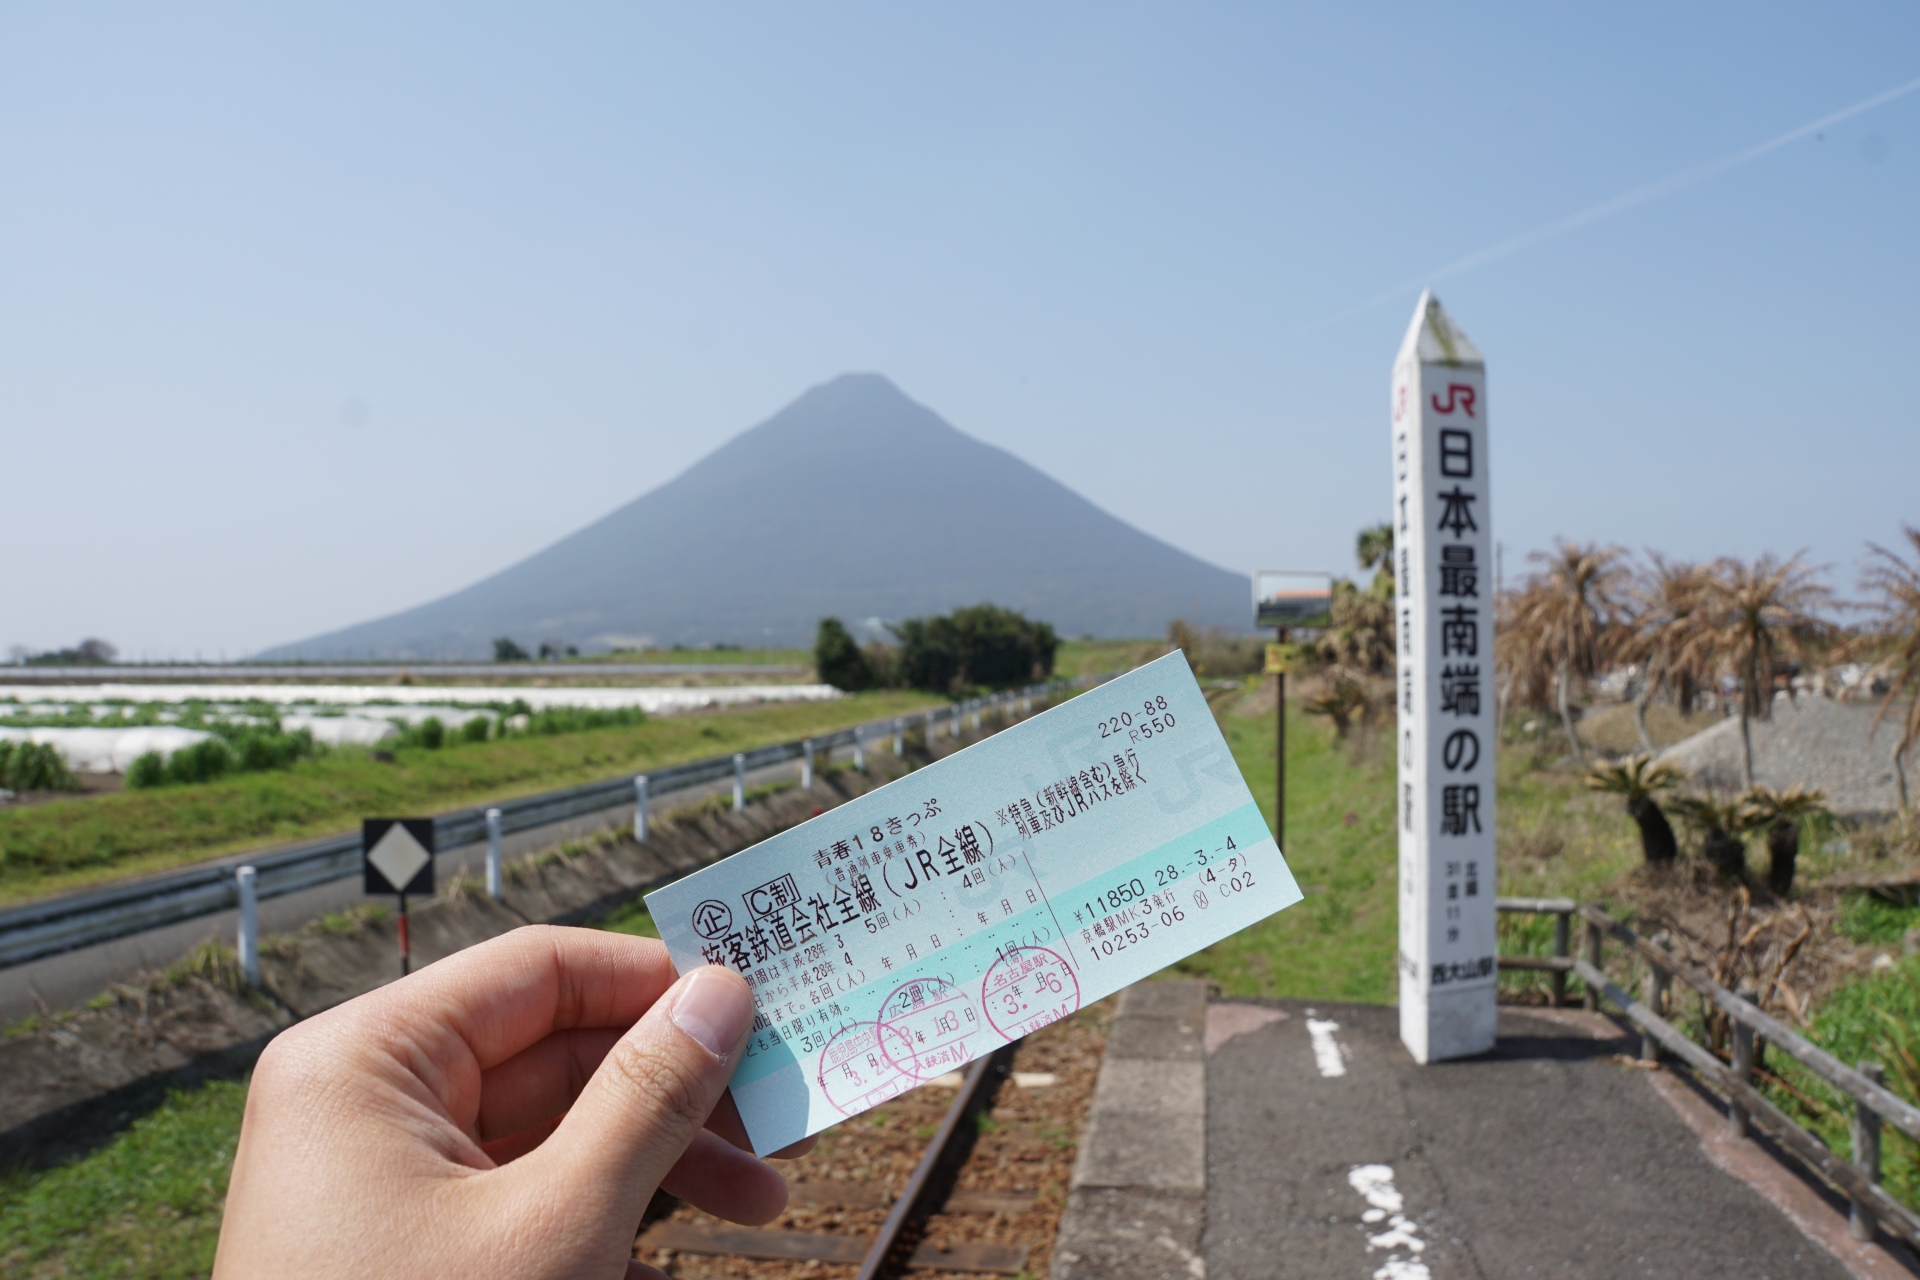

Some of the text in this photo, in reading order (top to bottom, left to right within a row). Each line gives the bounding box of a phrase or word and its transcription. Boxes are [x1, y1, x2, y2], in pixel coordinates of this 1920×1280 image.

[1431, 383, 1477, 418] JR
[1438, 427, 1482, 836] 日本最南端の駅
[1097, 694, 1167, 738] 220-88
[1127, 712, 1175, 744] R550
[811, 797, 942, 869] 青春18きっぷ
[962, 854, 1016, 888] 4回（人）
[750, 879, 794, 913] C制
[863, 898, 920, 934] 5回（人）
[1072, 877, 1145, 924] ¥11850
[1090, 905, 1185, 961] 10253-06
[1218, 870, 1255, 897] C02
[989, 951, 1050, 989] 名古屋駅
[745, 1003, 851, 1058] とも当日限り有効。
